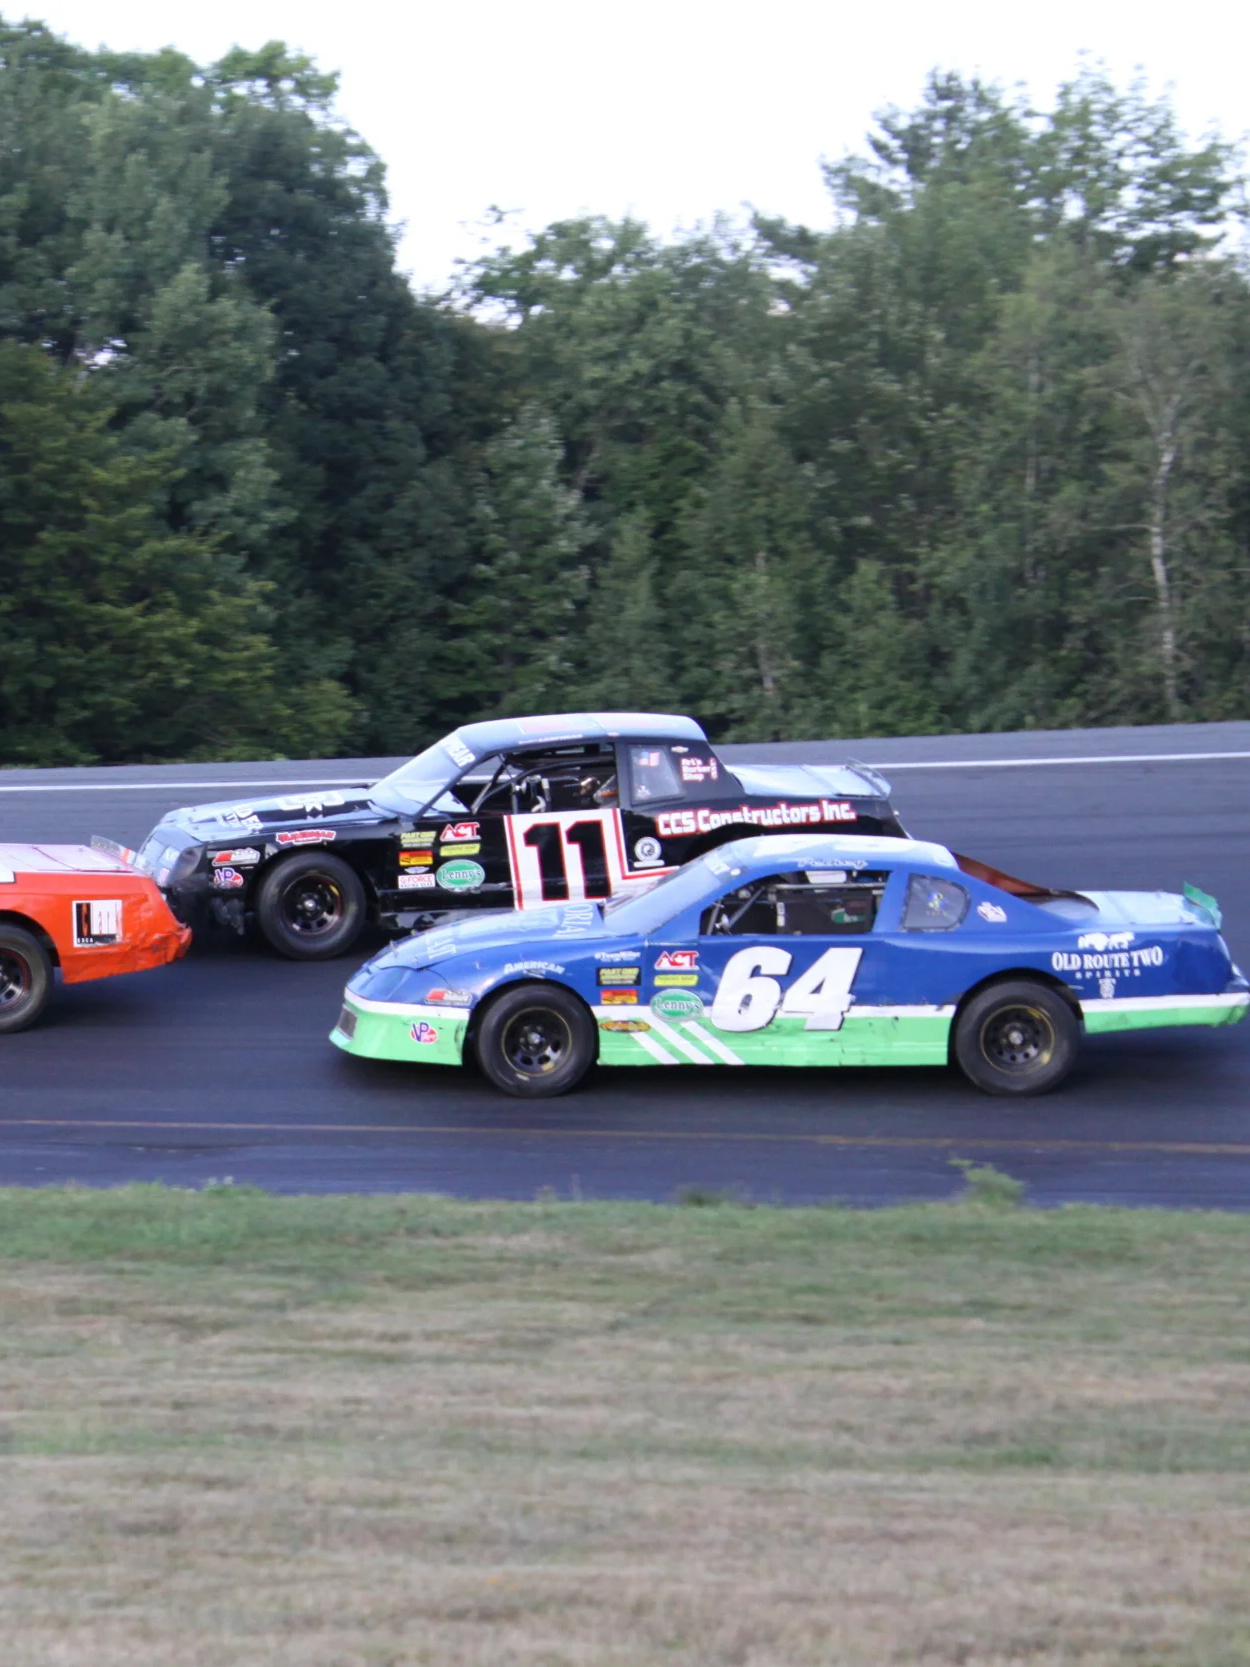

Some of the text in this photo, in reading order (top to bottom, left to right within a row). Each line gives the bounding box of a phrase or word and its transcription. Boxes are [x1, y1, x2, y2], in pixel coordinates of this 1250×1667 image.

[658, 799, 857, 836] CCS Constructors Inc.
[440, 821, 481, 842] ACT
[523, 819, 612, 902] 11
[441, 867, 482, 881] Lenny's
[503, 961, 566, 975] AMERICAN
[654, 950, 699, 971] ACT
[1052, 945, 1164, 971] OLD ROUTE TWO
[1075, 968, 1141, 980] SPIRITS
[711, 945, 864, 1032] 64
[656, 998, 701, 1012] Lenny's
